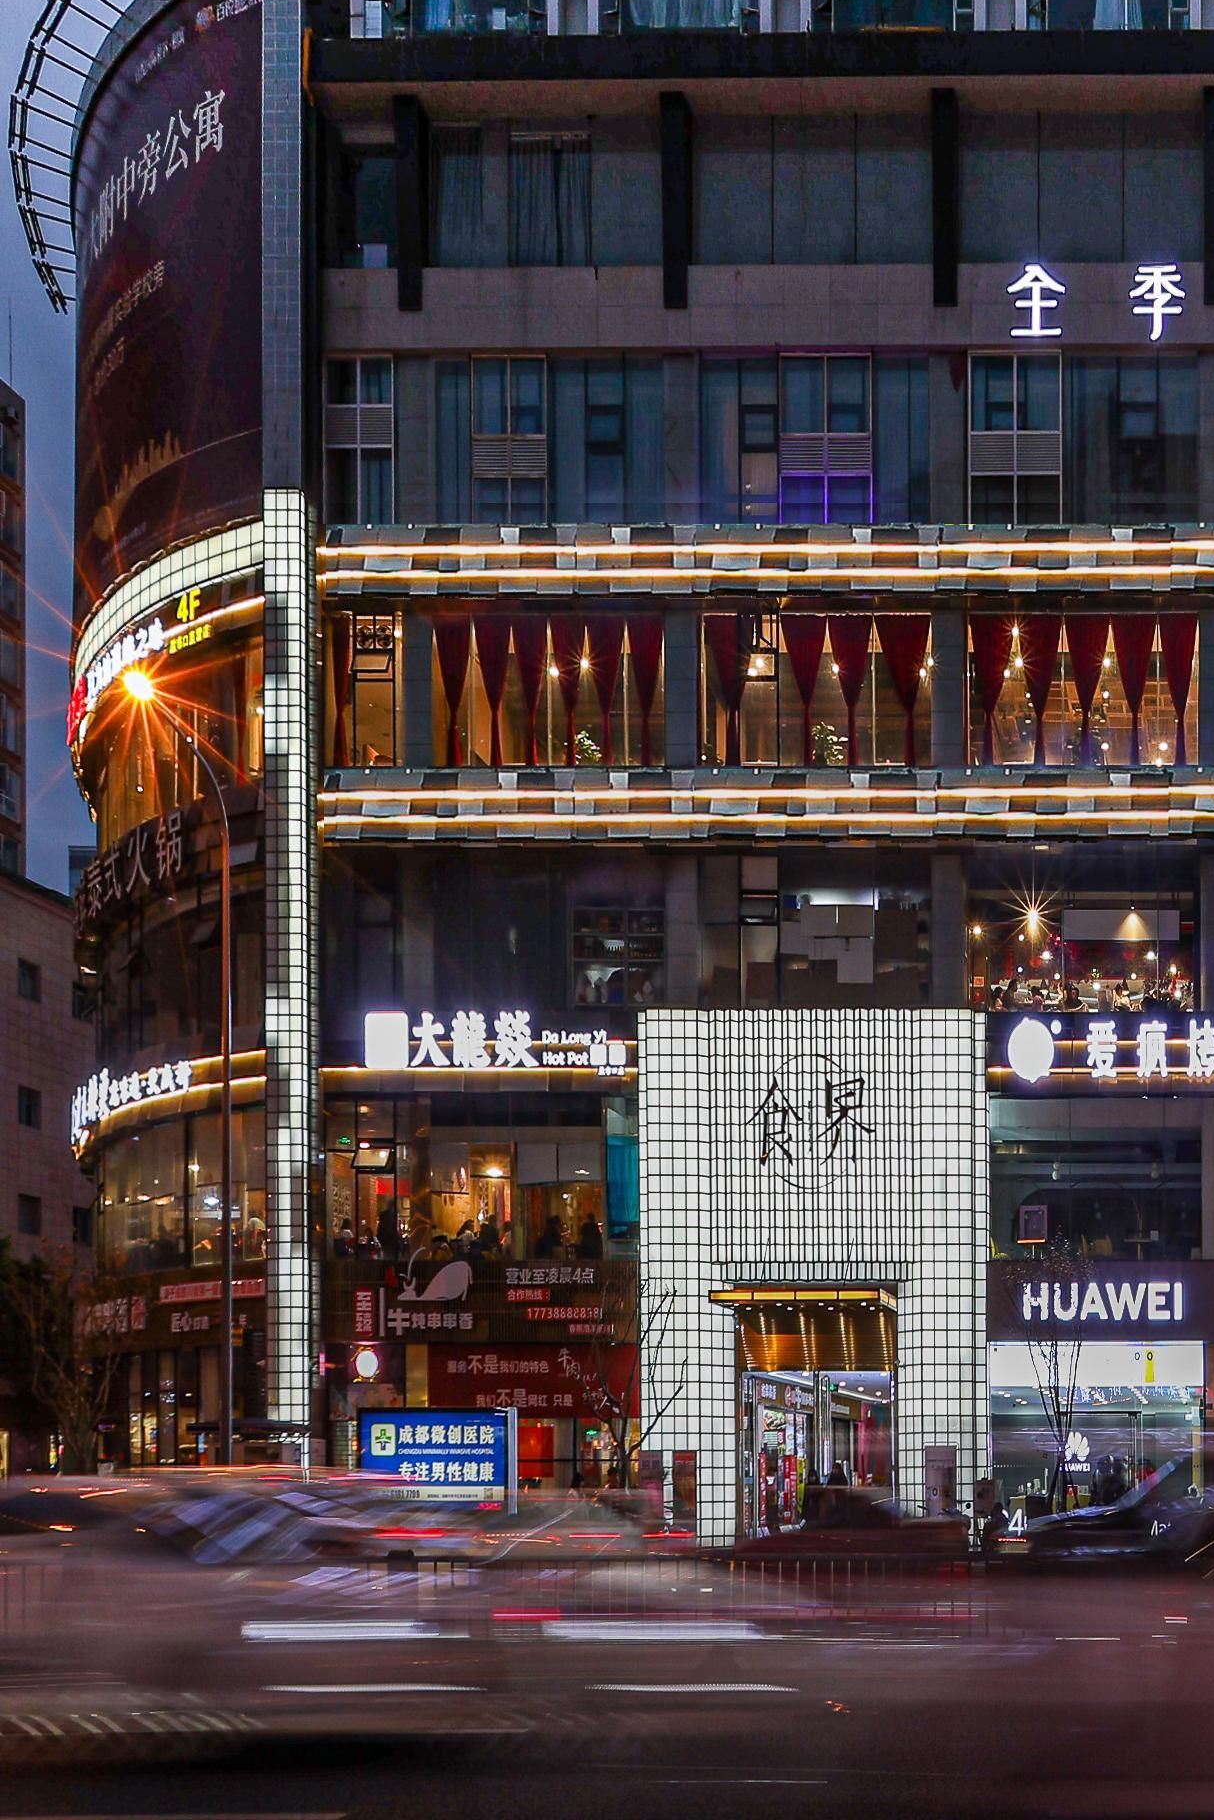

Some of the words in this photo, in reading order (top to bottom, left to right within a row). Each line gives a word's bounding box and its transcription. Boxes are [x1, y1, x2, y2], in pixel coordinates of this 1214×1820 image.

[176, 587, 202, 623] 4F
[541, 1029, 559, 1045] Da
[561, 1029, 592, 1046] Long
[542, 1050, 566, 1066] Hot
[567, 1050, 589, 1066] Pot
[505, 1267, 594, 1285] 营业至凌晨4点
[1022, 1281, 1184, 1321] HUAWEI
[447, 1354, 550, 1374] 服务不是我们的特色
[475, 1388, 548, 1408] 我们不是网红
[552, 1393, 574, 1407] 只是
[398, 1424, 495, 1445] 成都微创医院
[398, 1461, 495, 1482] 专注男性健康
